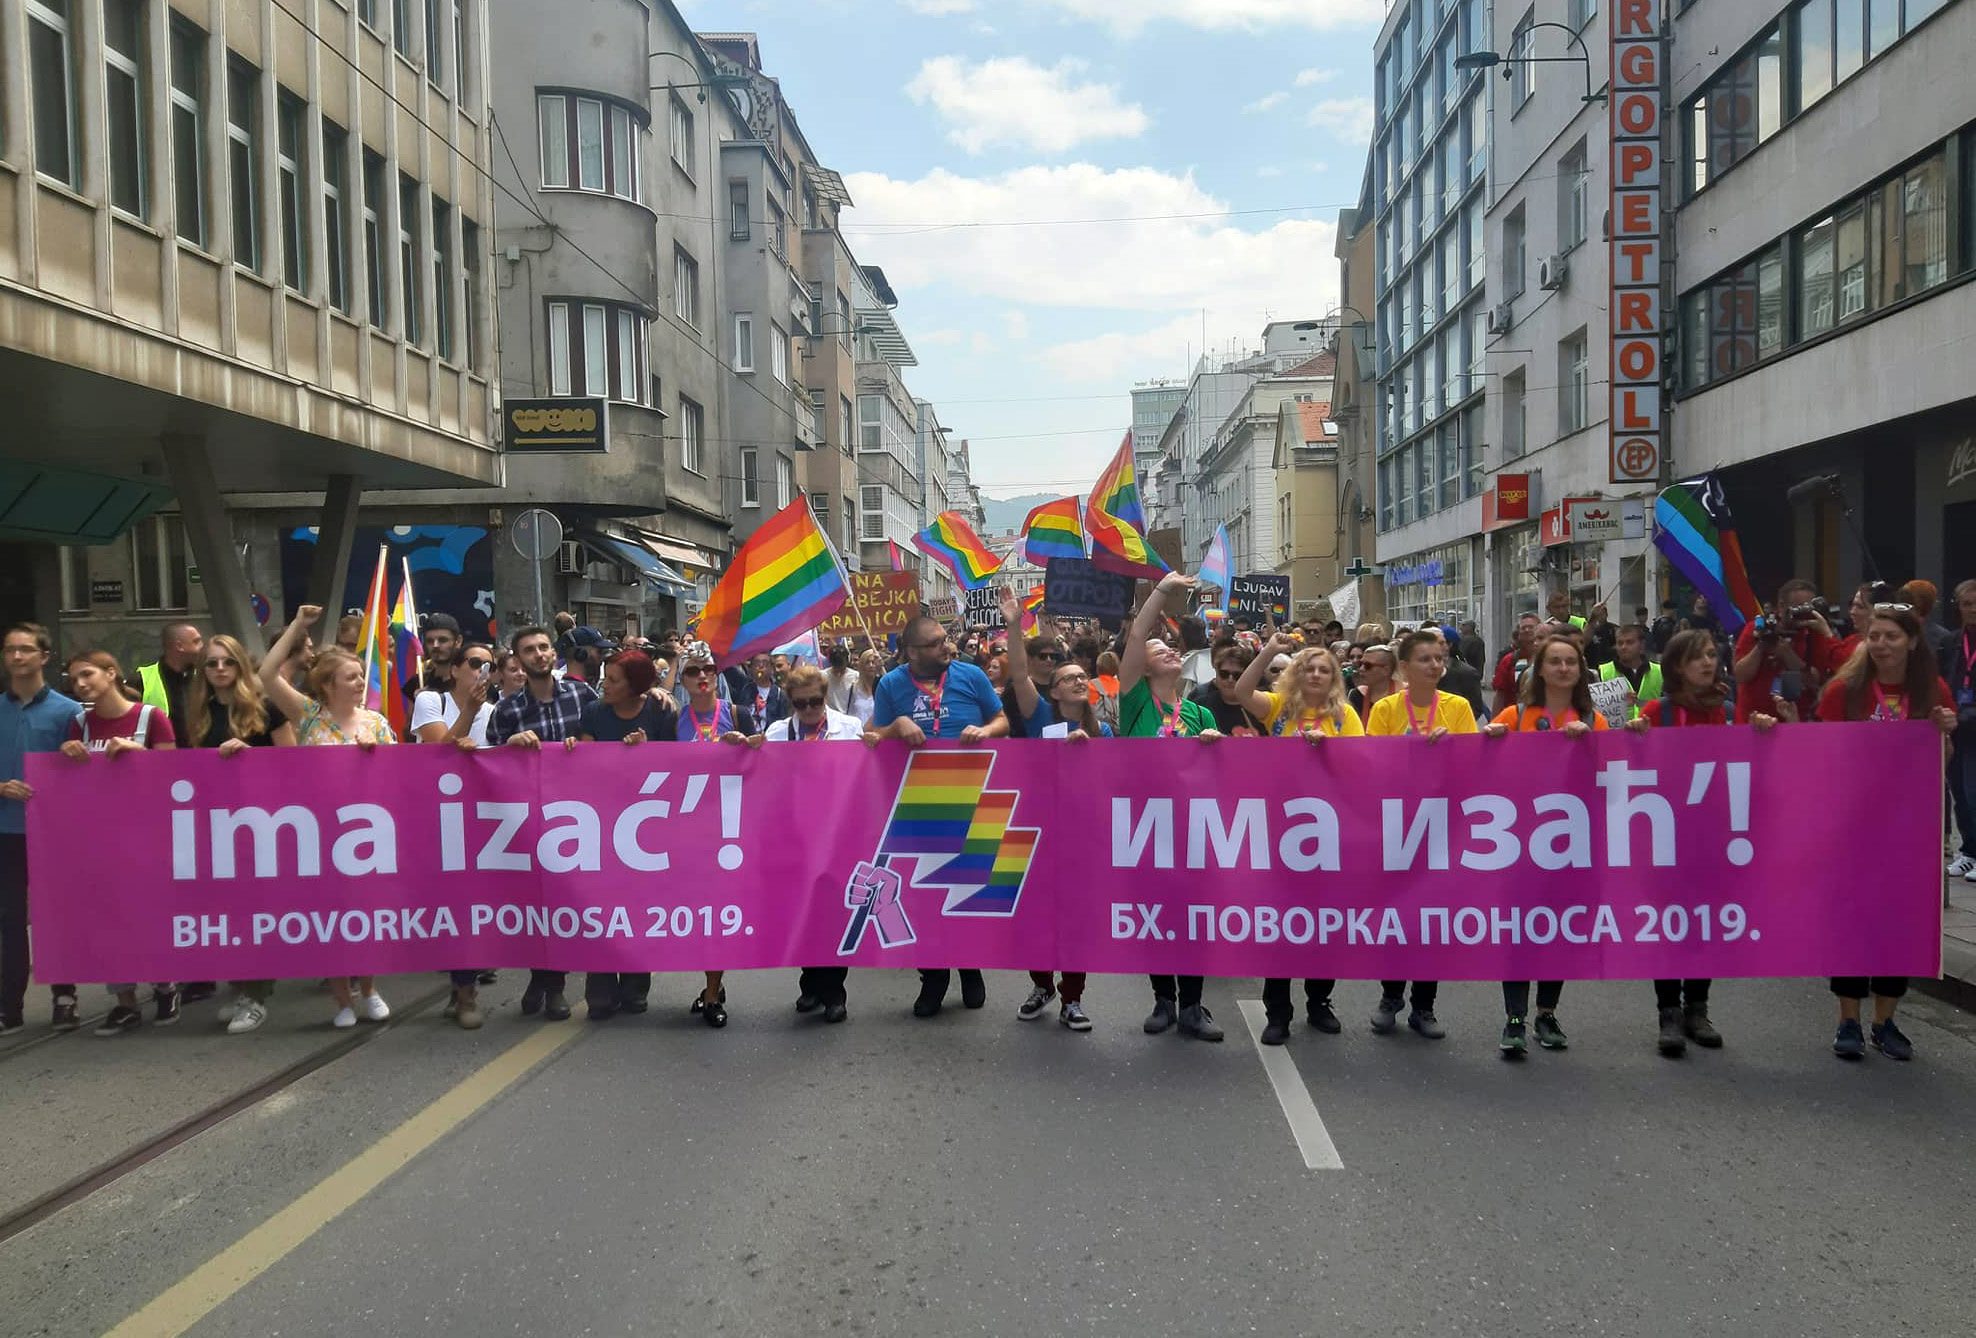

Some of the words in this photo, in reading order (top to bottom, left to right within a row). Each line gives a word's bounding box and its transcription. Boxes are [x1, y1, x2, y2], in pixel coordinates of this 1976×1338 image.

[1620, 0, 1655, 428] RGOPETROL
[964, 586, 1001, 609] REFUGE
[171, 779, 398, 880] ima
[1111, 797, 1341, 872] има
[173, 914, 241, 947] BH.
[253, 906, 460, 945] POVORKA
[471, 904, 634, 939] PONOSA
[645, 904, 754, 938] 2019.
[1111, 902, 1176, 941] БХ.
[1188, 905, 1408, 945] ПОВОРКА
[1420, 905, 1622, 945] ПОНОСА
[1634, 903, 1761, 943] 2019.
